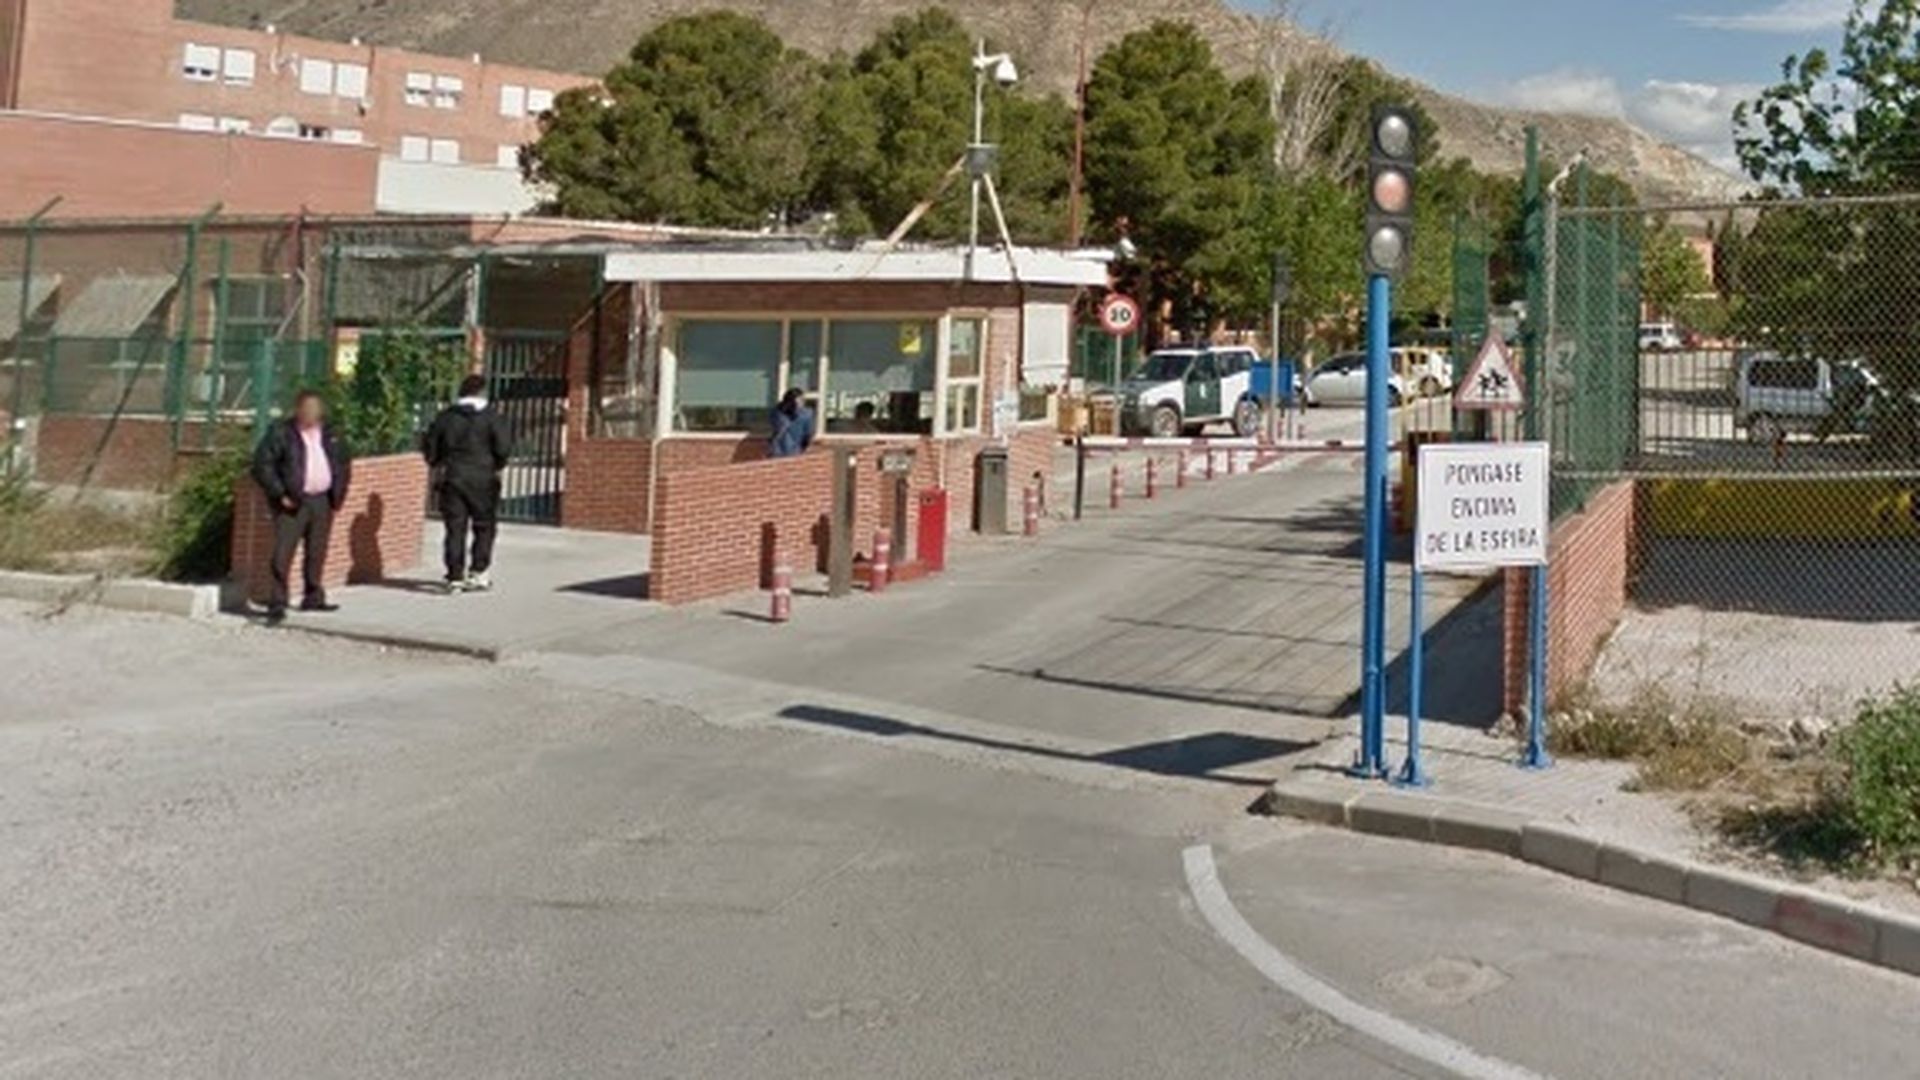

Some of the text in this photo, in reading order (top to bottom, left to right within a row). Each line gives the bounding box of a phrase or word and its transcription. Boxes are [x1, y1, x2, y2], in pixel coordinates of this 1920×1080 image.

[1451, 497, 1516, 519] ENCIMA
[1427, 532, 1448, 554] DE
[1454, 530, 1474, 553] LA
